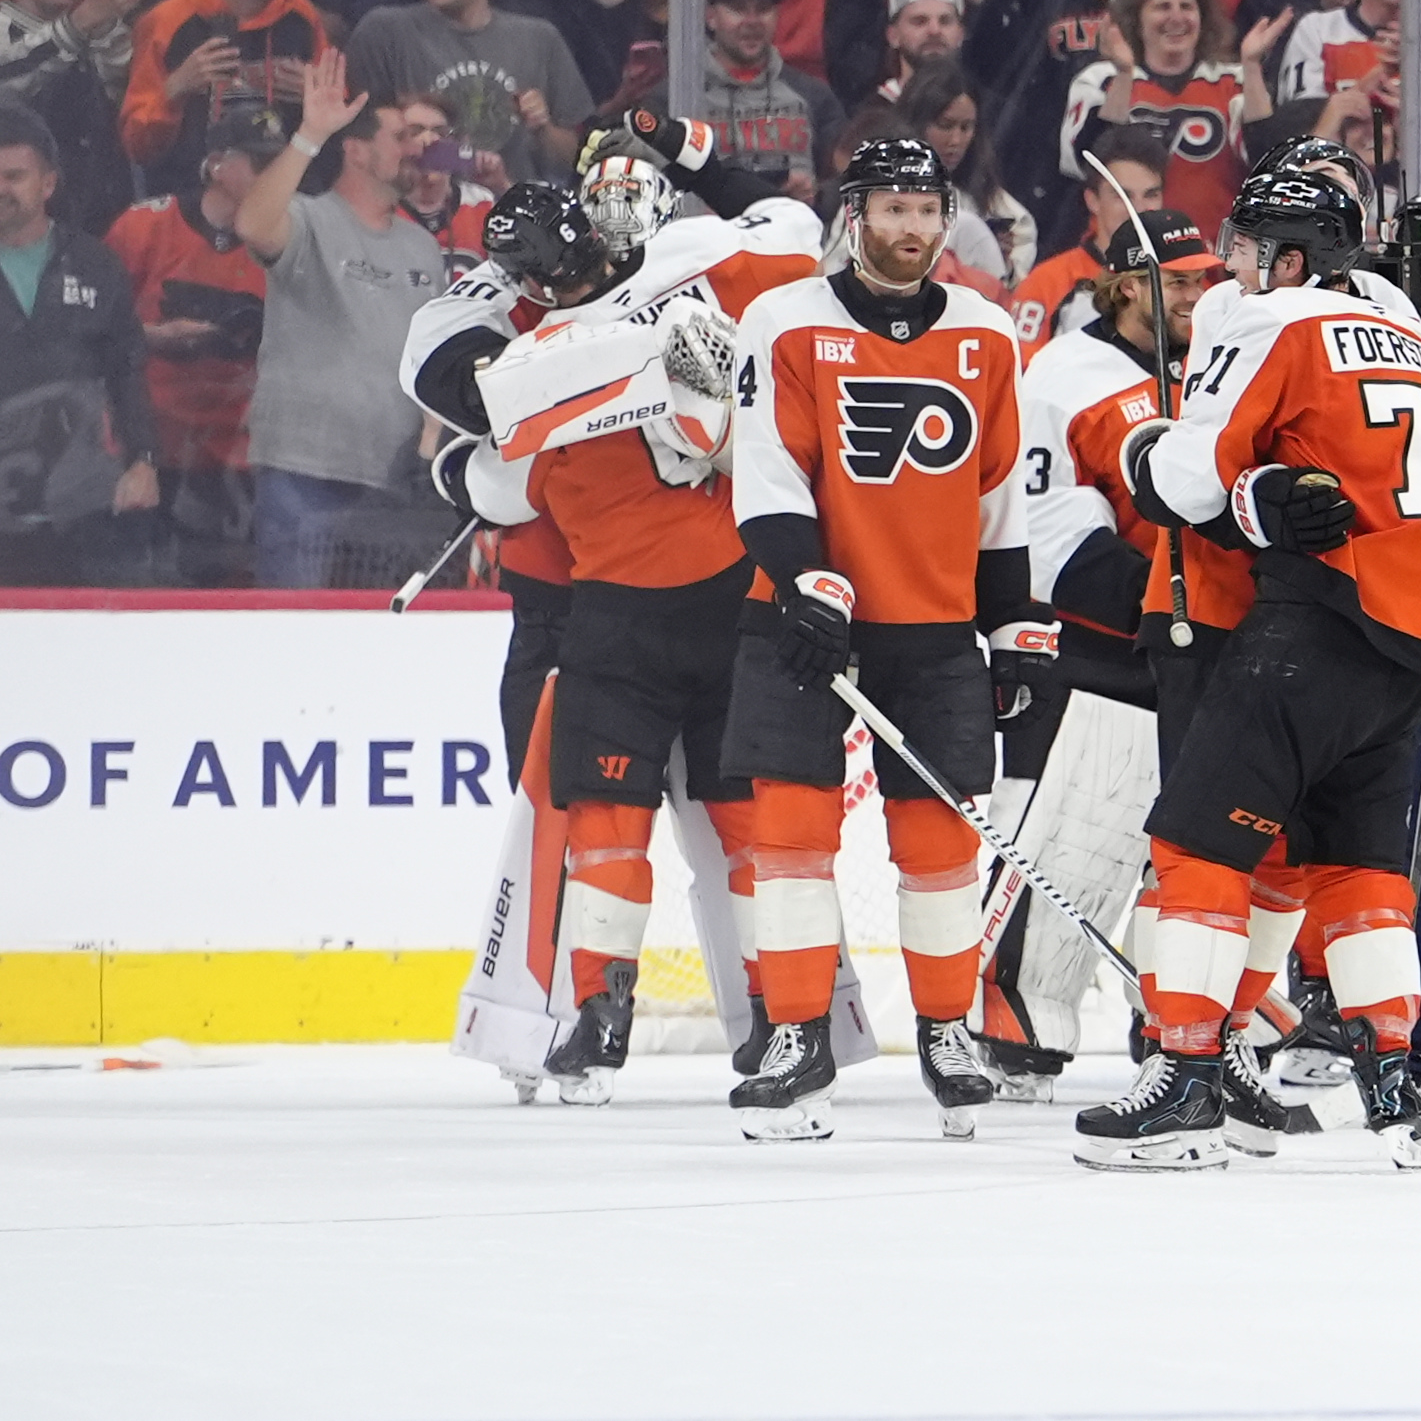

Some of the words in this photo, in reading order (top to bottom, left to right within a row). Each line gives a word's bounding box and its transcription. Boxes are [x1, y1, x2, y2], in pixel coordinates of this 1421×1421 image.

[559, 222, 576, 243] 6
[814, 340, 855, 364] IBX
[957, 338, 979, 379] C
[1119, 394, 1158, 424] IBX
[0, 740, 135, 809] OF
[172, 740, 493, 809] AMER
